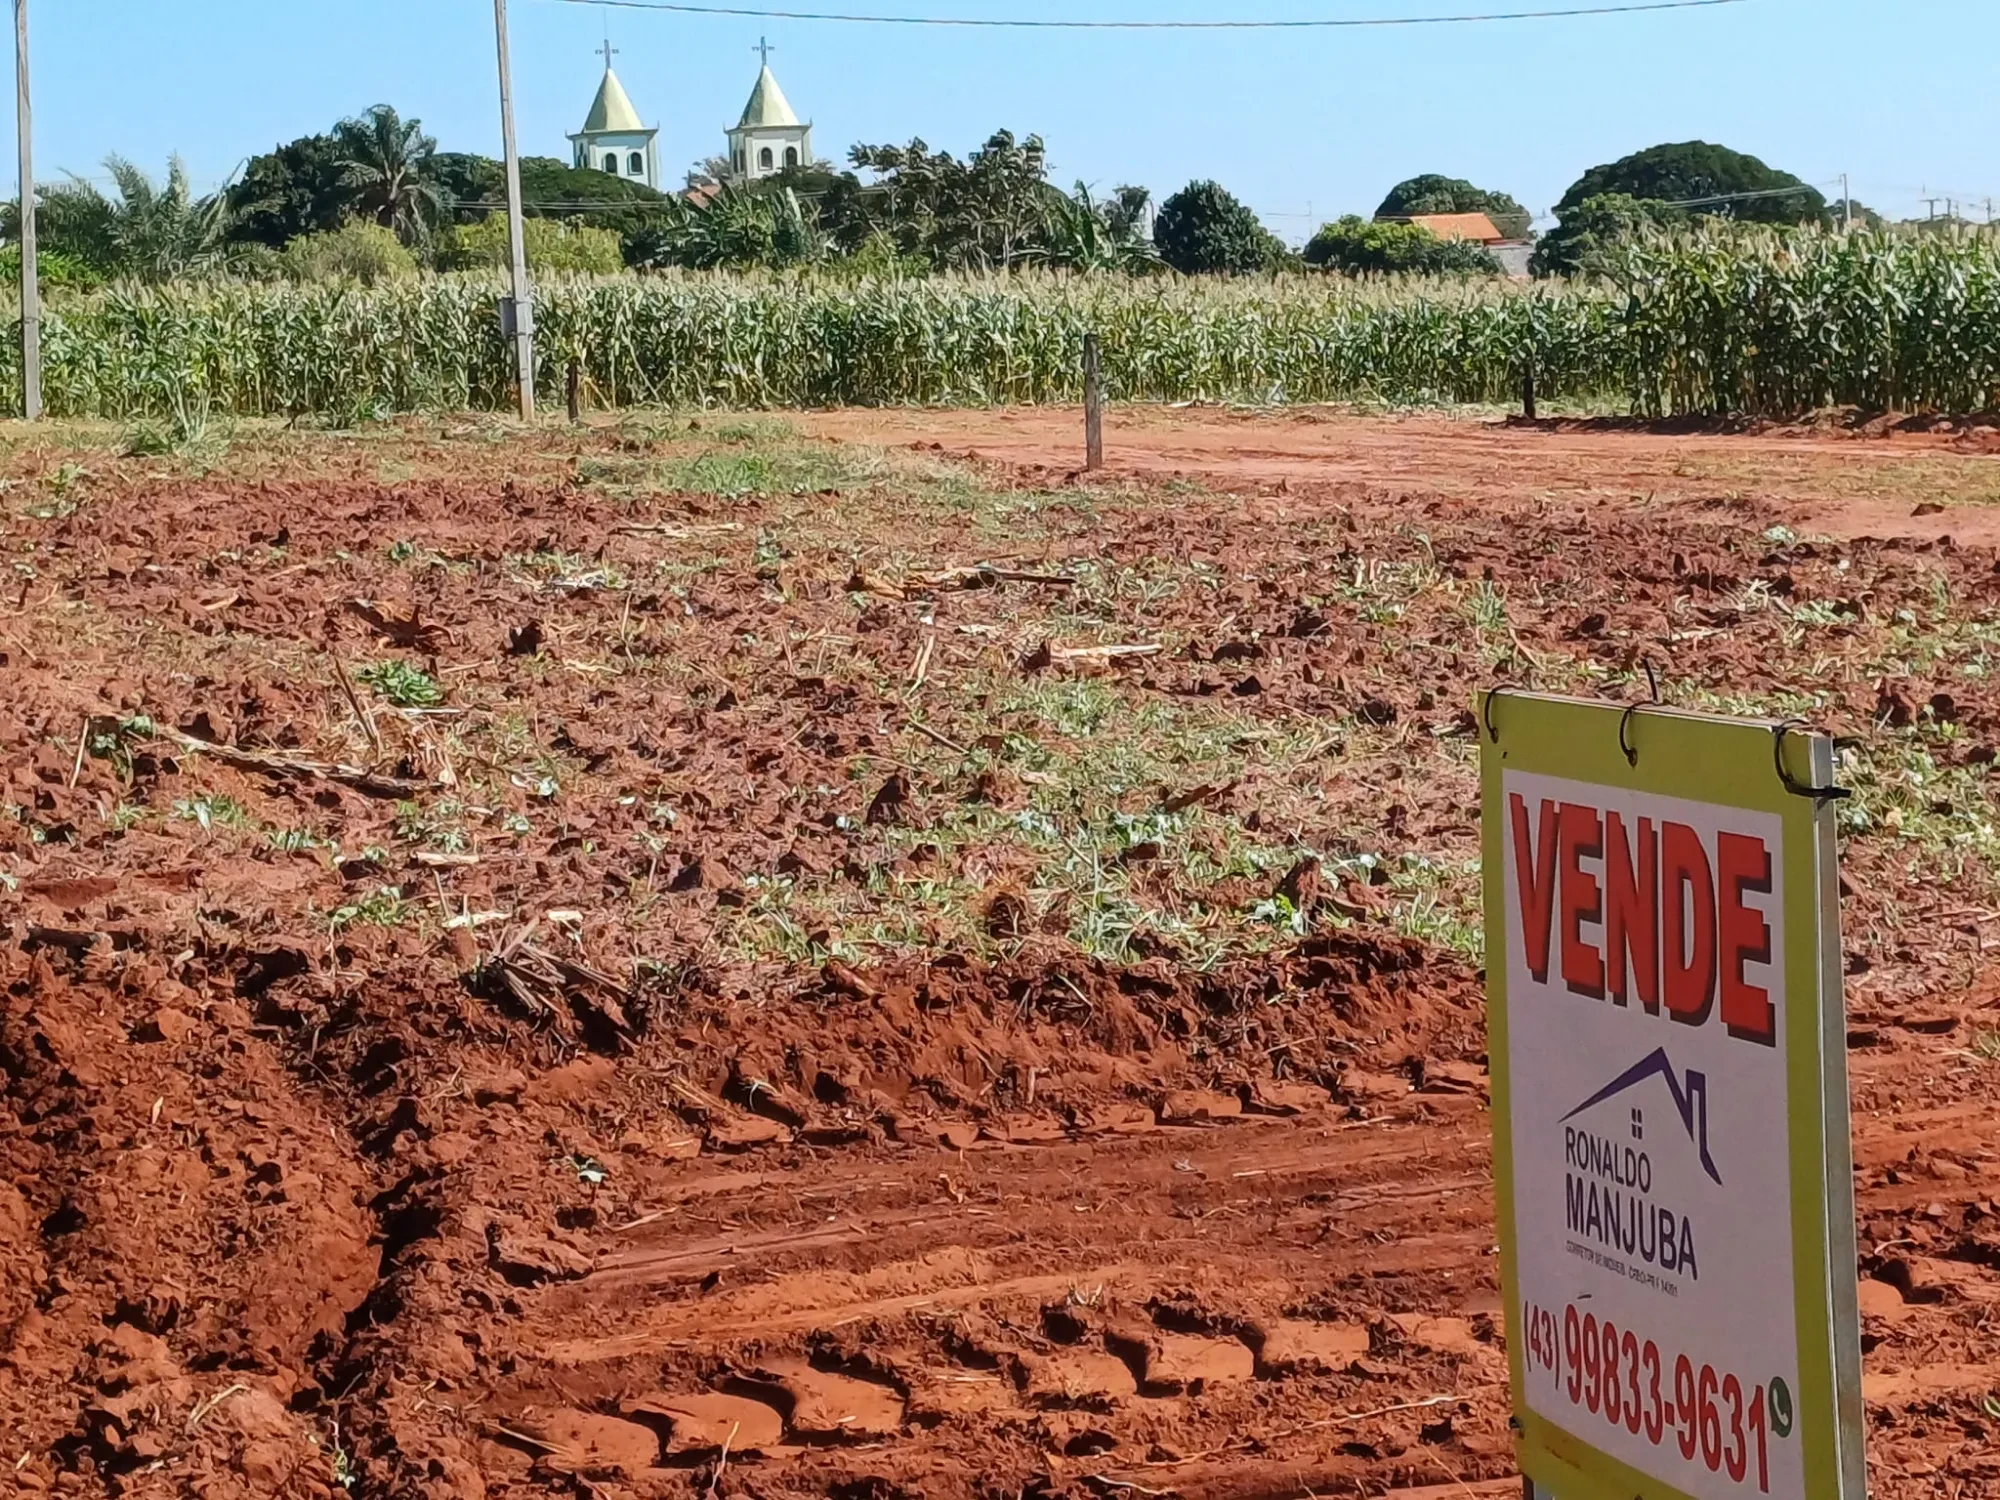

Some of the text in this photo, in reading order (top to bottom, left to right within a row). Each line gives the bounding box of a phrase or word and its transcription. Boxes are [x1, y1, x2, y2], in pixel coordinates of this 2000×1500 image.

[1509, 793, 1776, 1047] VENDE
[1565, 1126, 1651, 1193] RONALDO
[1566, 1173, 1698, 1280] MANJUBA
[1524, 1300, 1769, 1494] (43) 99833-9631
